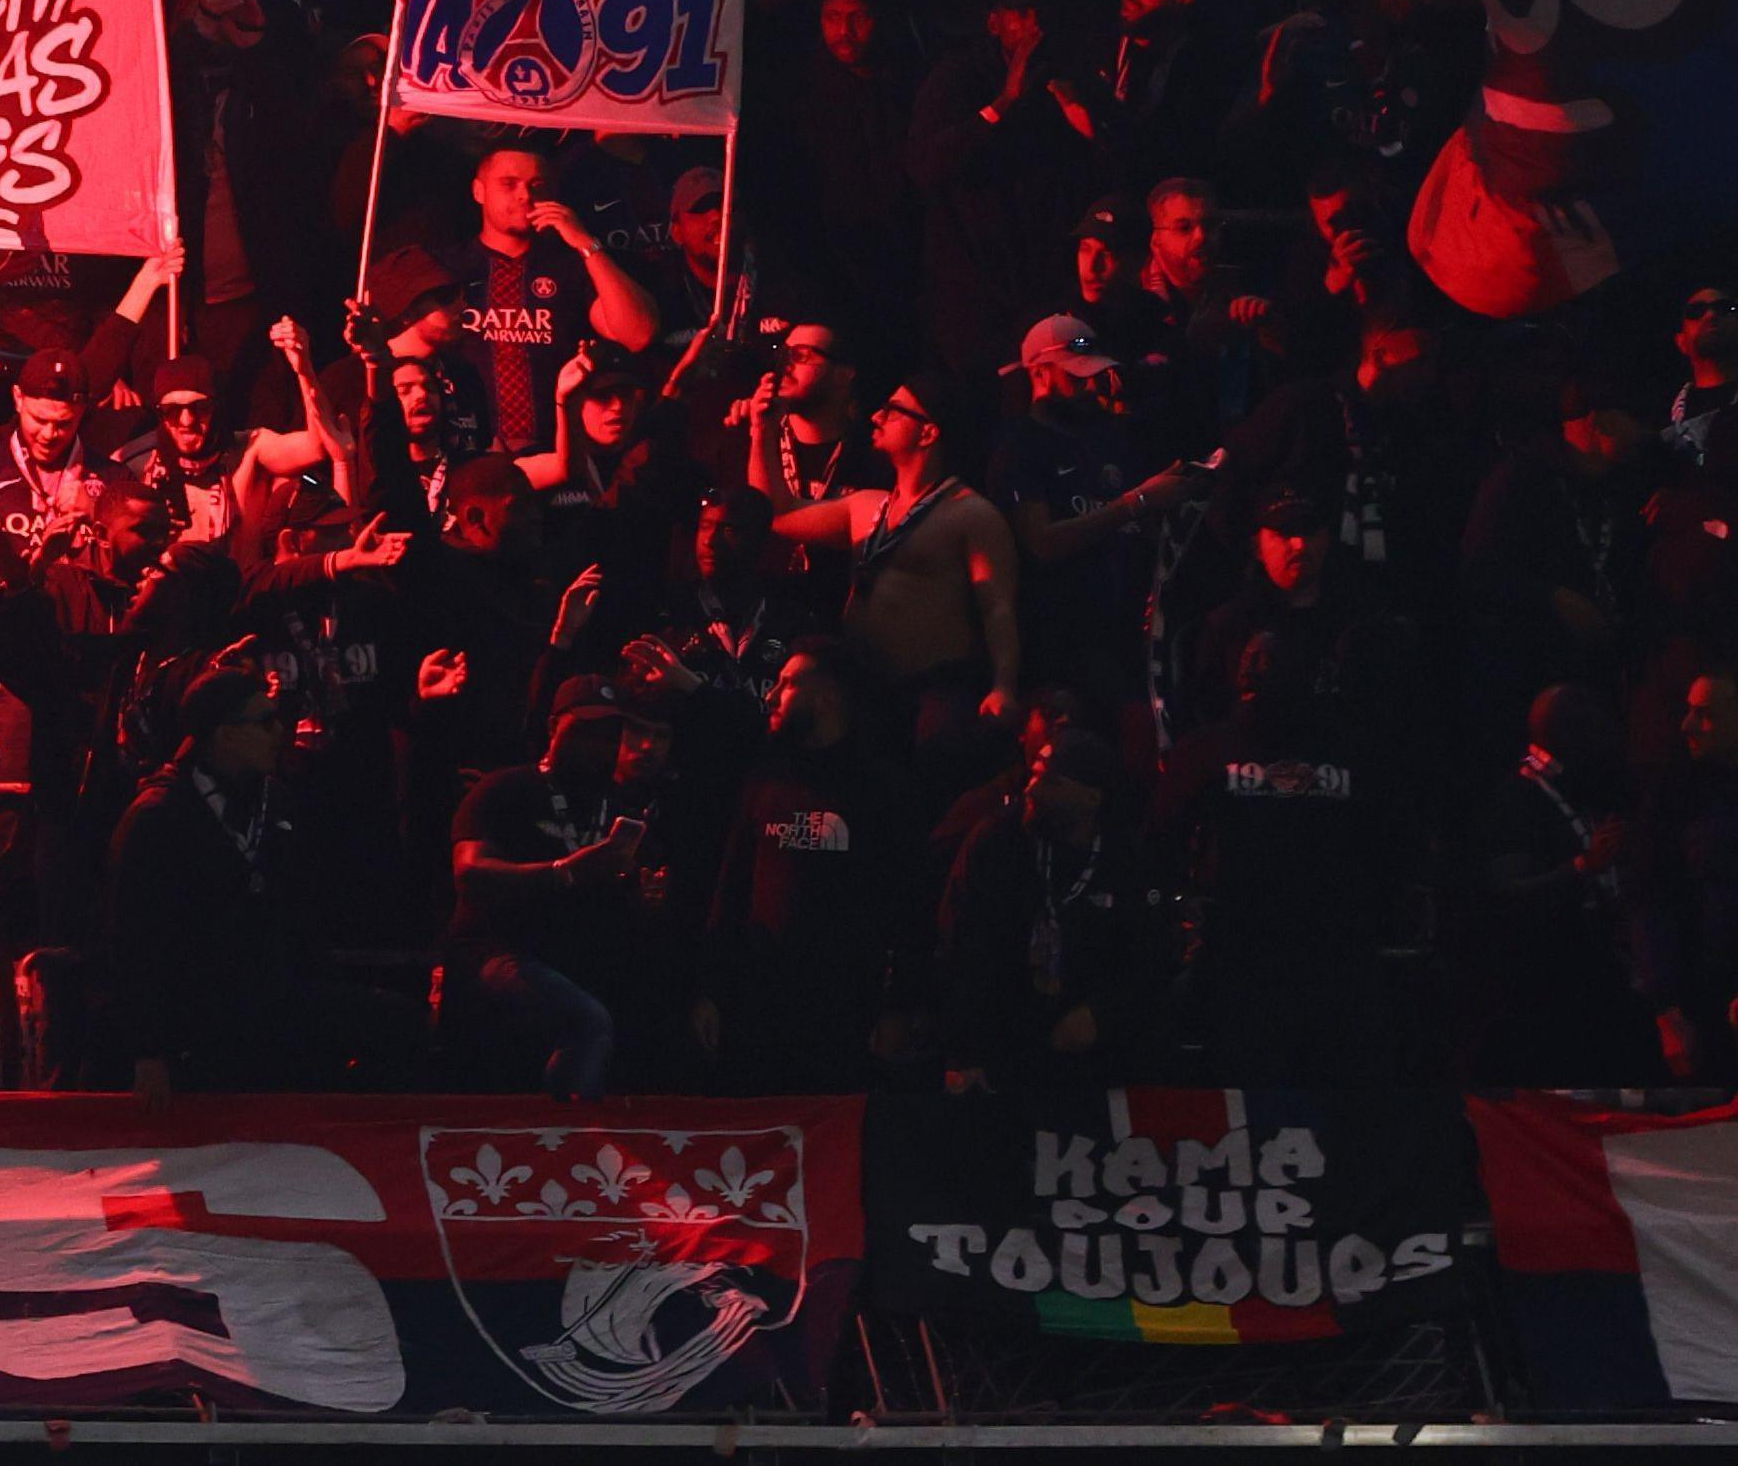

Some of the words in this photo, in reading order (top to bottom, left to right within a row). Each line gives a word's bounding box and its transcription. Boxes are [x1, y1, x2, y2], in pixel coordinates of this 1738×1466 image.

[607, 223, 672, 249] QAT
[461, 307, 552, 333] QATAR
[483, 329, 552, 345] AIRWAYS
[1225, 761, 1267, 791] 19
[1316, 762, 1352, 797] 91
[765, 823, 822, 838] NORTH
[793, 811, 822, 825] THE
[778, 836, 823, 851] FACE
[1033, 1127, 1326, 1198] KAMA
[907, 1223, 1454, 1307] TOUJOURS
